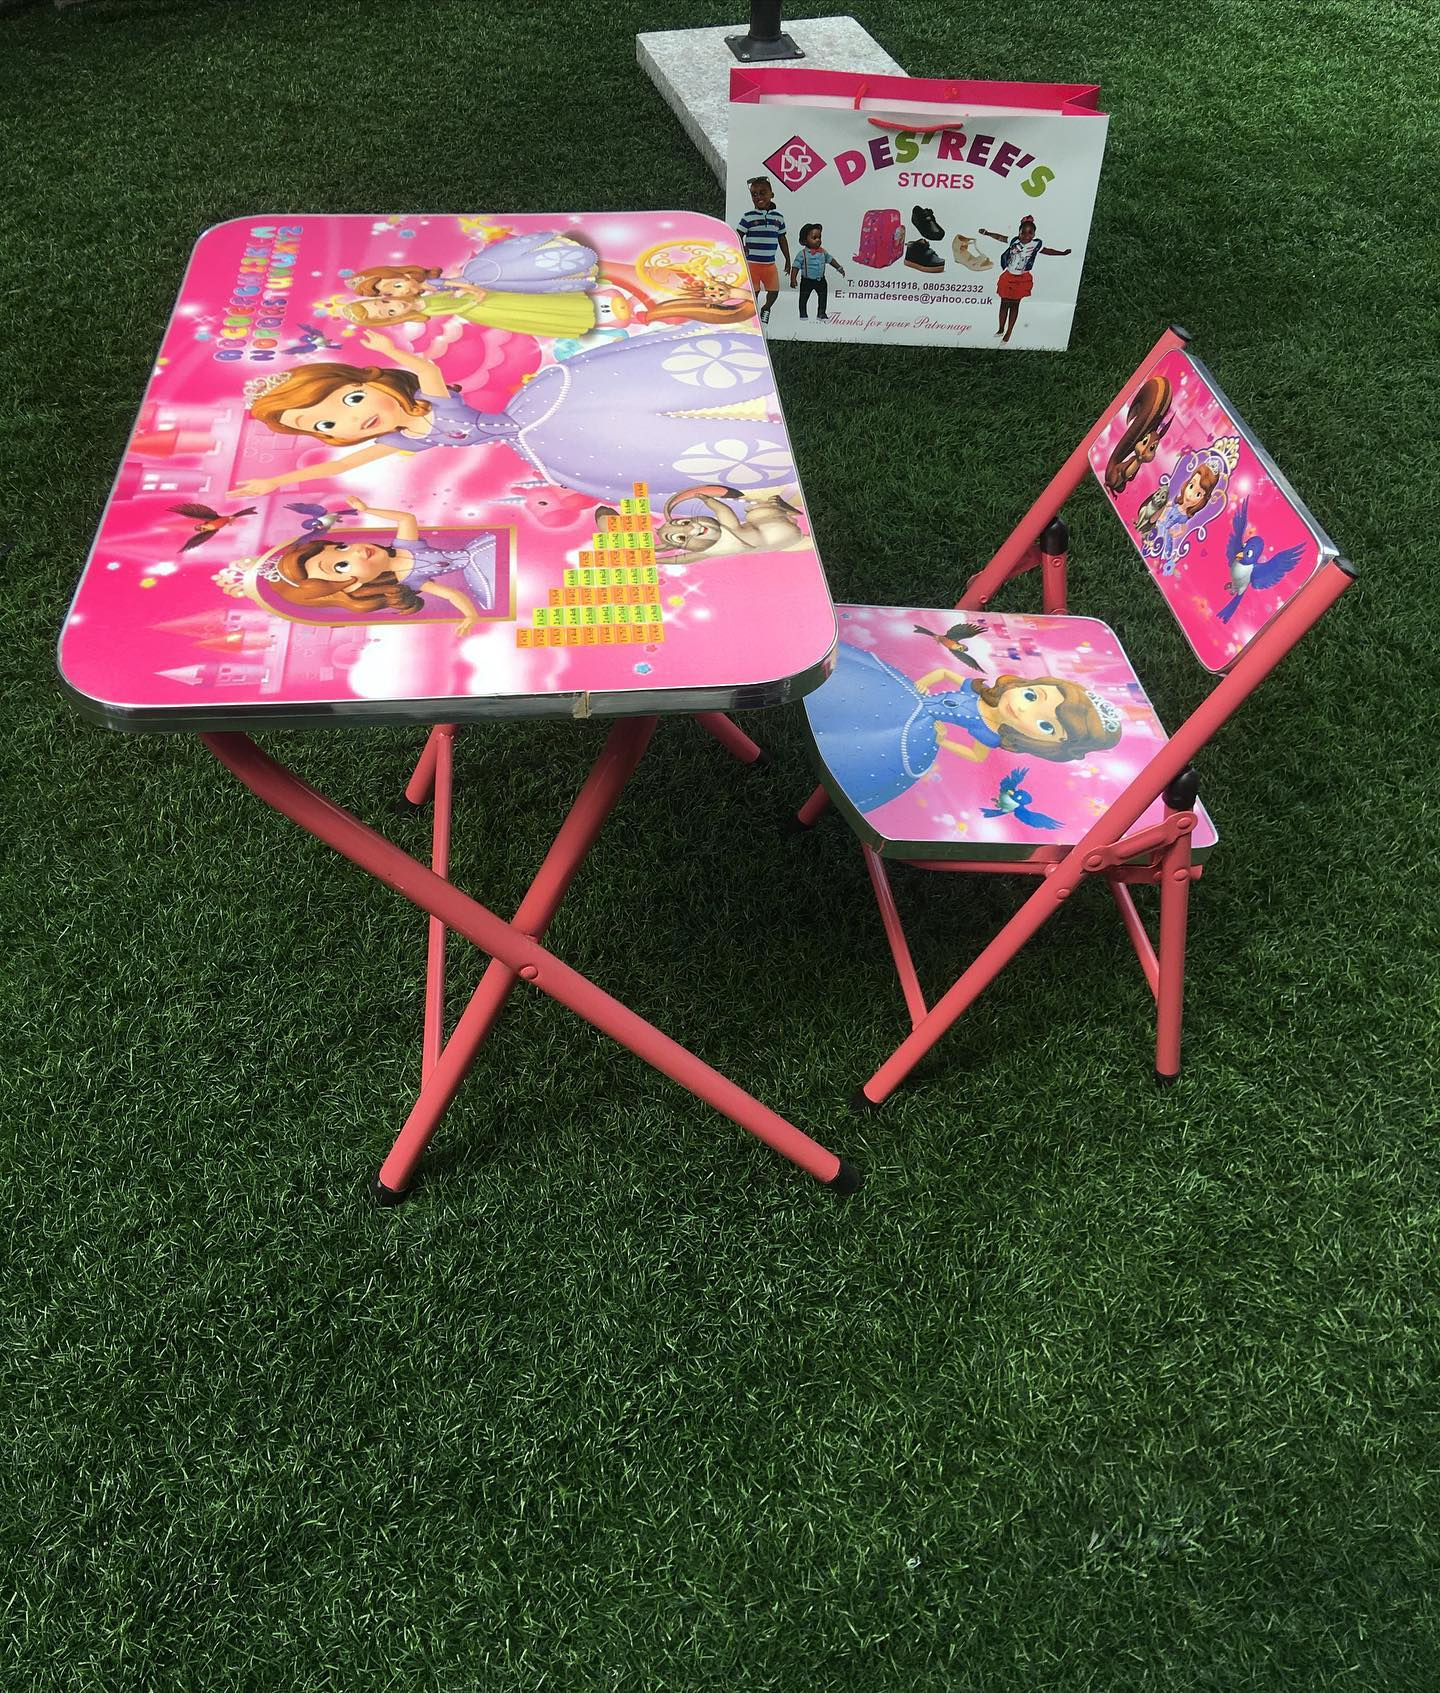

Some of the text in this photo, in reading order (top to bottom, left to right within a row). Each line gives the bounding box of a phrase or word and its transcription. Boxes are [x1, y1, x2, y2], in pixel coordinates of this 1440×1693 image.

[833, 130, 1055, 198] DES'REE'S
[897, 172, 974, 190] STORES
[847, 279, 984, 293] T: 08033411918, 08053622332
[835, 290, 993, 305] E: mamadesrees@yahoo.co.uk
[864, 316, 882, 330] for
[885, 321, 911, 332] your
[913, 315, 973, 336] Patronage
